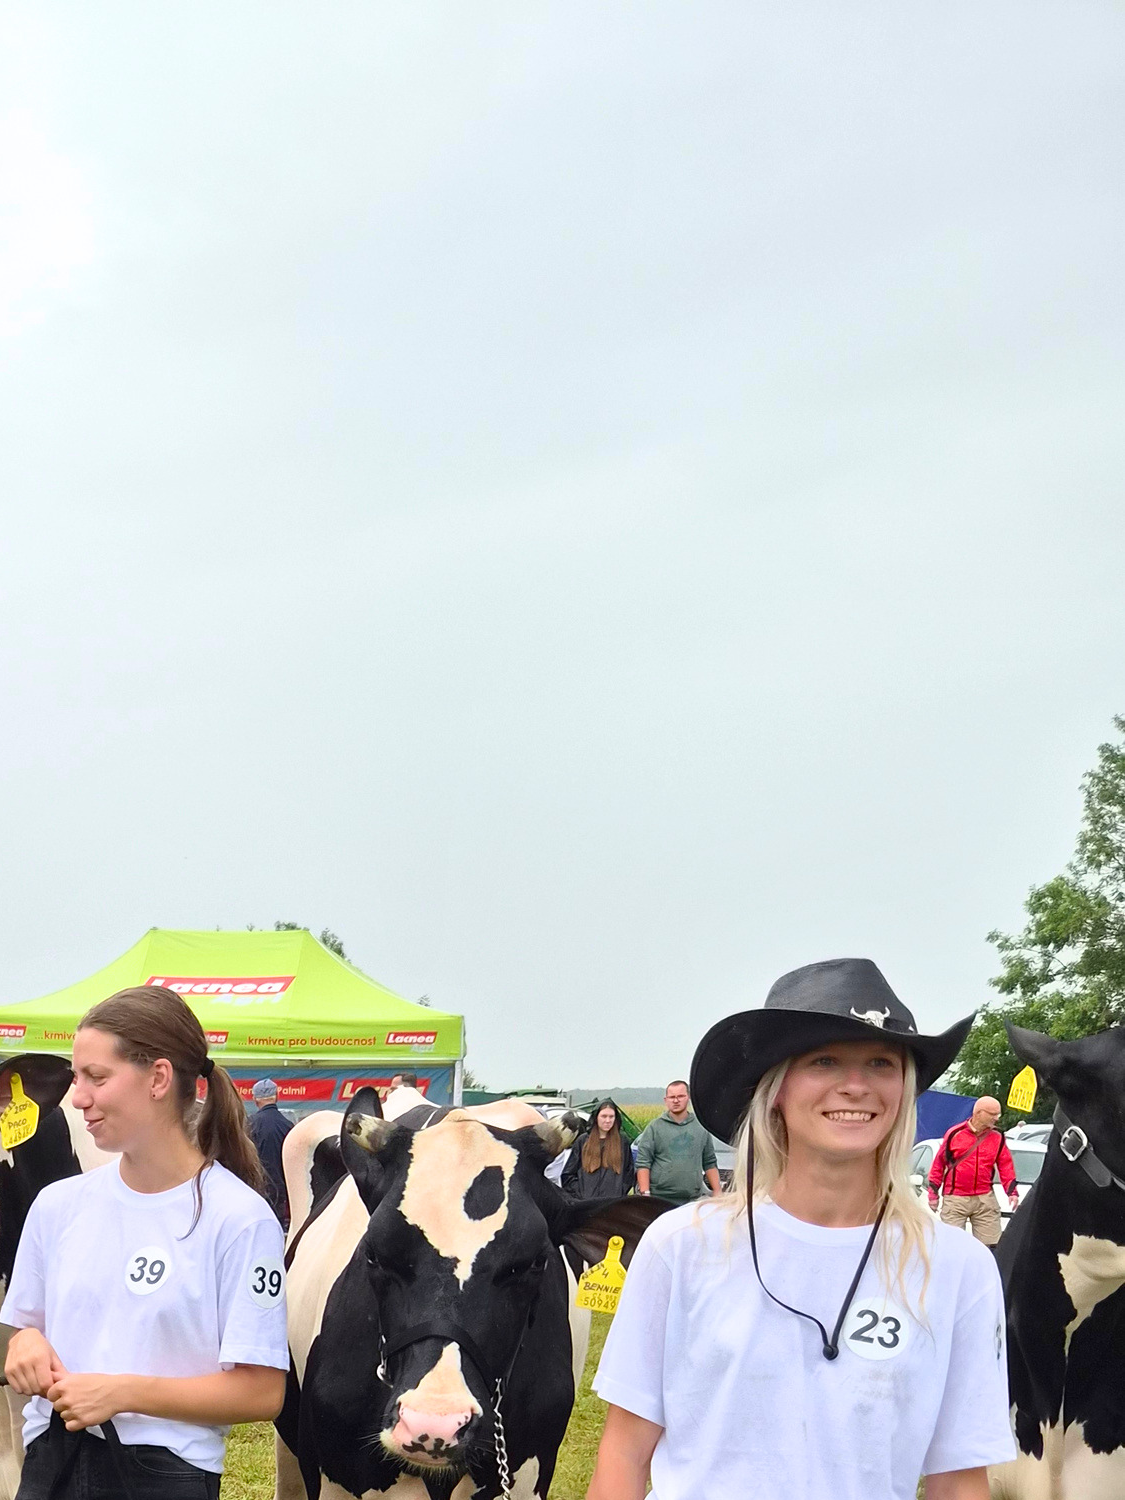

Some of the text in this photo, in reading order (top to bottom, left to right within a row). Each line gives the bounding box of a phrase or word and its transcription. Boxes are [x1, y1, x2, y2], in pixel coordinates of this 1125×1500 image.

[288, 1038, 307, 1049] pro
[310, 1036, 377, 1047] budoucnost
[387, 1033, 435, 1044] Lacnea
[129, 1256, 166, 1286] 39
[252, 1265, 282, 1298] 39
[583, 1281, 622, 1294] BENNIE
[849, 1309, 902, 1349] 23
